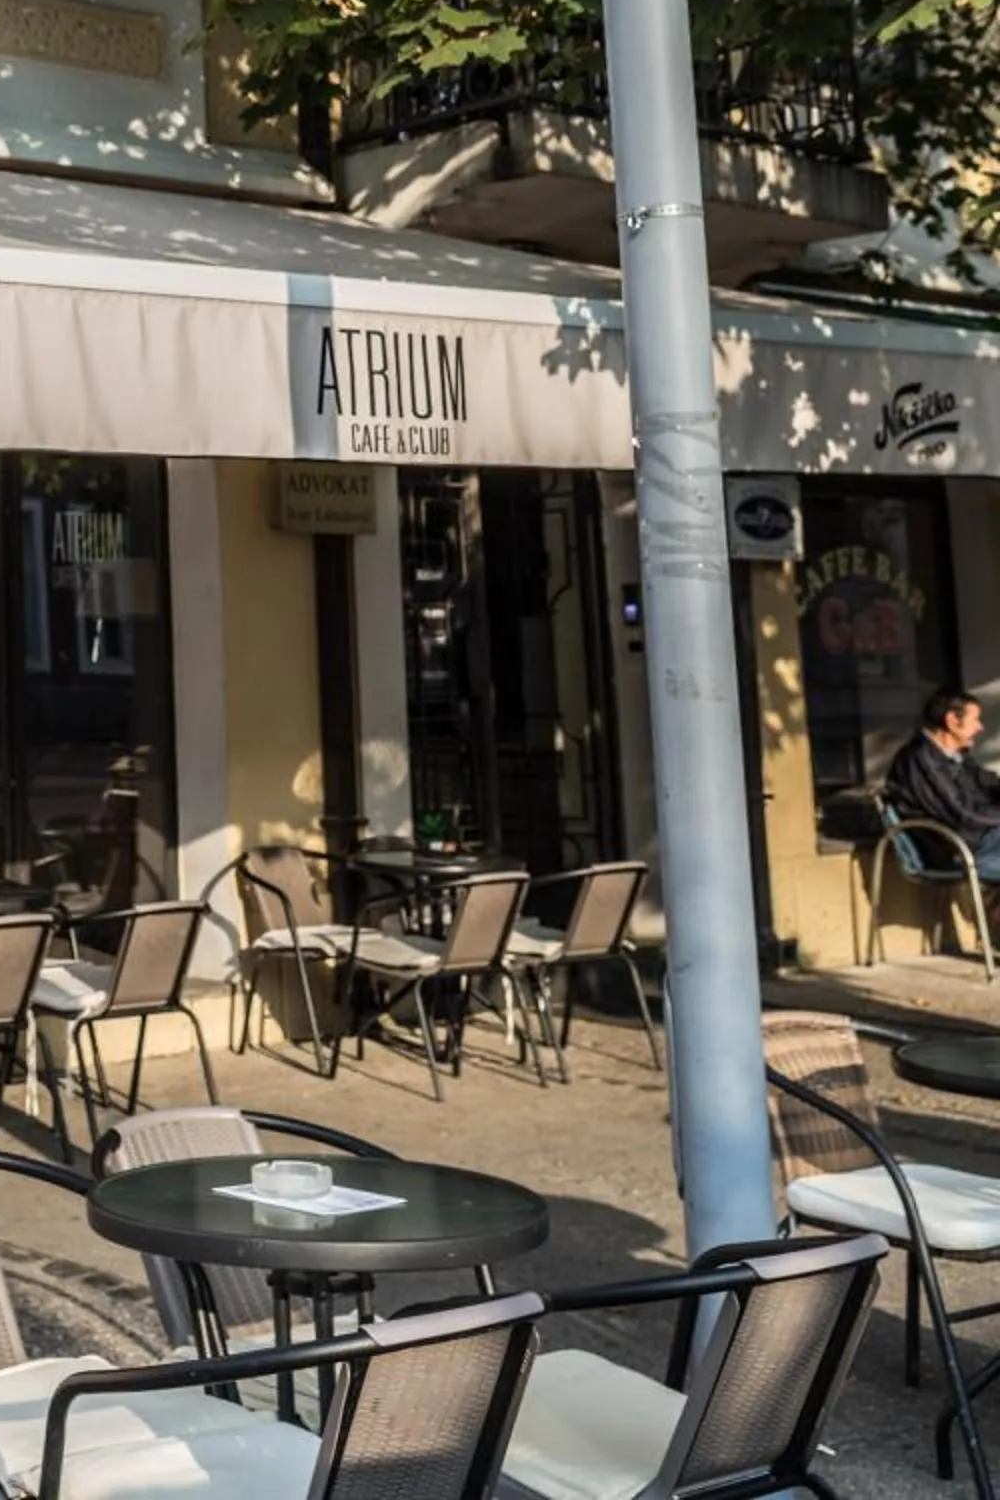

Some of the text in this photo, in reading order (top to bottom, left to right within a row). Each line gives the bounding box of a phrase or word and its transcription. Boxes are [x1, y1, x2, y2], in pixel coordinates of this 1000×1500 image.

[317, 326, 467, 422] ATRIUM
[351, 423, 392, 455] CAFE
[287, 473, 369, 496] ADVOKAT
[52, 511, 124, 564] ATRIUM
